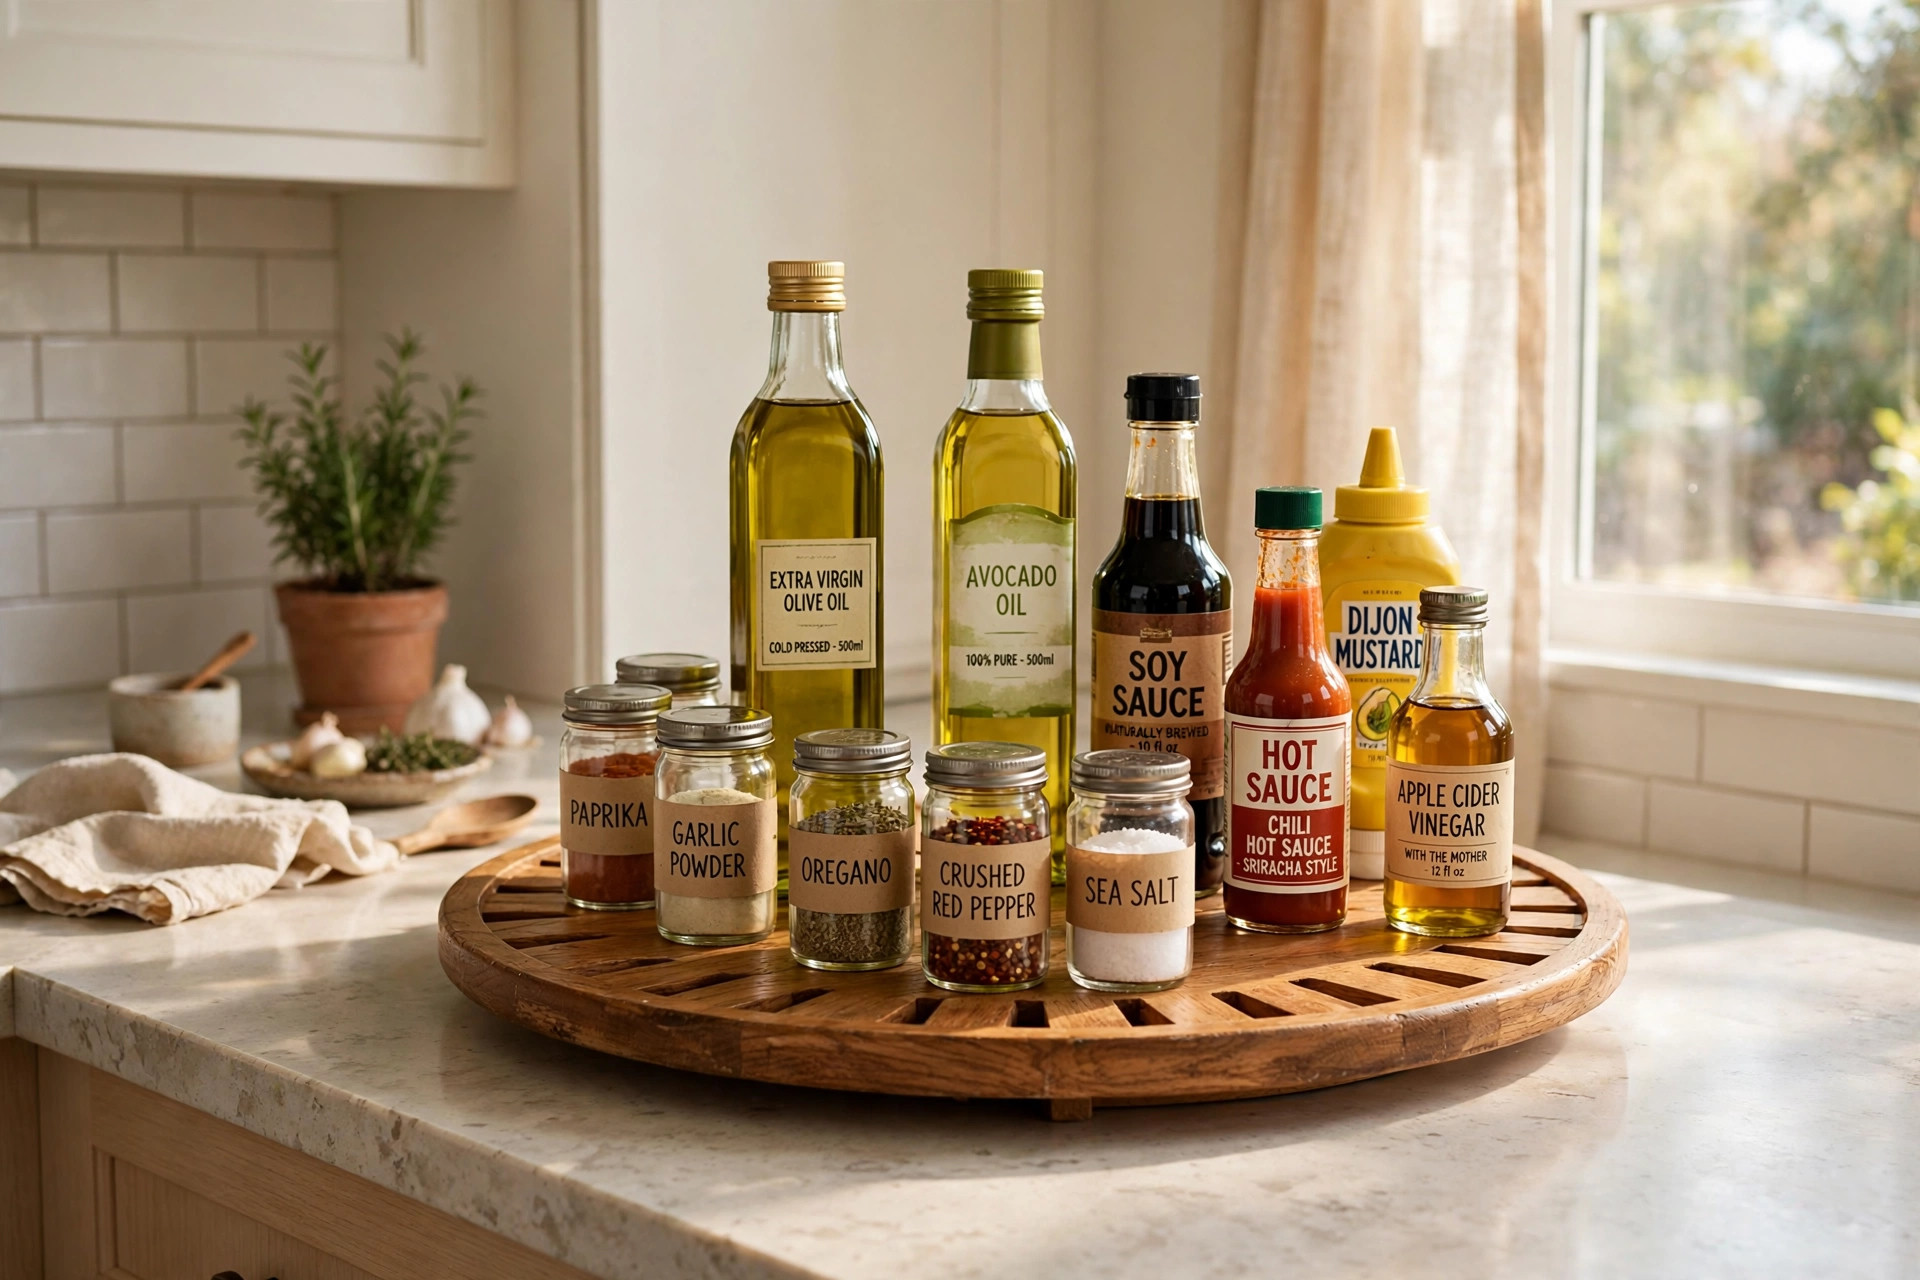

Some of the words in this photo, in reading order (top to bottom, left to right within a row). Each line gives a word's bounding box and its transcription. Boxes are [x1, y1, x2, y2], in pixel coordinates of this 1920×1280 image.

[770, 571, 813, 589] EXTRA
[816, 570, 863, 588] VIRGIN
[966, 564, 1057, 588] AVOCADO
[784, 593, 823, 611] OLIVE
[827, 592, 849, 610] OIL
[996, 593, 1027, 616] OIL
[1348, 606, 1412, 635] DIJON
[769, 641, 792, 653] COLD
[794, 641, 830, 653] PRESSED
[838, 640, 863, 651] 500ml
[966, 654, 991, 666] 100%
[993, 653, 1018, 666] PURE
[1026, 653, 1054, 665] 500ml
[1129, 650, 1188, 682] SOY
[1112, 684, 1205, 718] SAUCE
[1105, 723, 1162, 738] NATURALLY
[1166, 725, 1209, 738] BREWED
[1138, 741, 1151, 751] 10
[1166, 743, 1178, 753] oz
[1262, 739, 1317, 770] HOT
[1246, 772, 1332, 804] SAUCE
[1397, 779, 1447, 808] APPLE
[1452, 782, 1500, 808] CIDER
[570, 799, 648, 828] PAPRIKA
[1268, 815, 1311, 835] CHILI
[1409, 810, 1486, 838] VINEGAR
[672, 820, 740, 848] GARLIC
[1246, 834, 1276, 856] HOT
[1281, 835, 1332, 857] SAUCE
[670, 850, 746, 879] POWDER
[1243, 857, 1302, 876] SRIRACHA
[1305, 856, 1338, 875] STYLE
[1404, 847, 1426, 861] WITH
[1429, 851, 1447, 863] THE
[1450, 850, 1488, 863] MOTHER
[801, 856, 892, 885] OREGANO
[940, 861, 1025, 888] CRUSHED
[1431, 865, 1441, 877] 12
[1443, 865, 1451, 877] fl
[1453, 868, 1465, 877] oz
[1085, 876, 1122, 906] SEA
[1130, 875, 1179, 907] SALT
[932, 890, 963, 919] RED
[970, 891, 1036, 921] PEPPER
